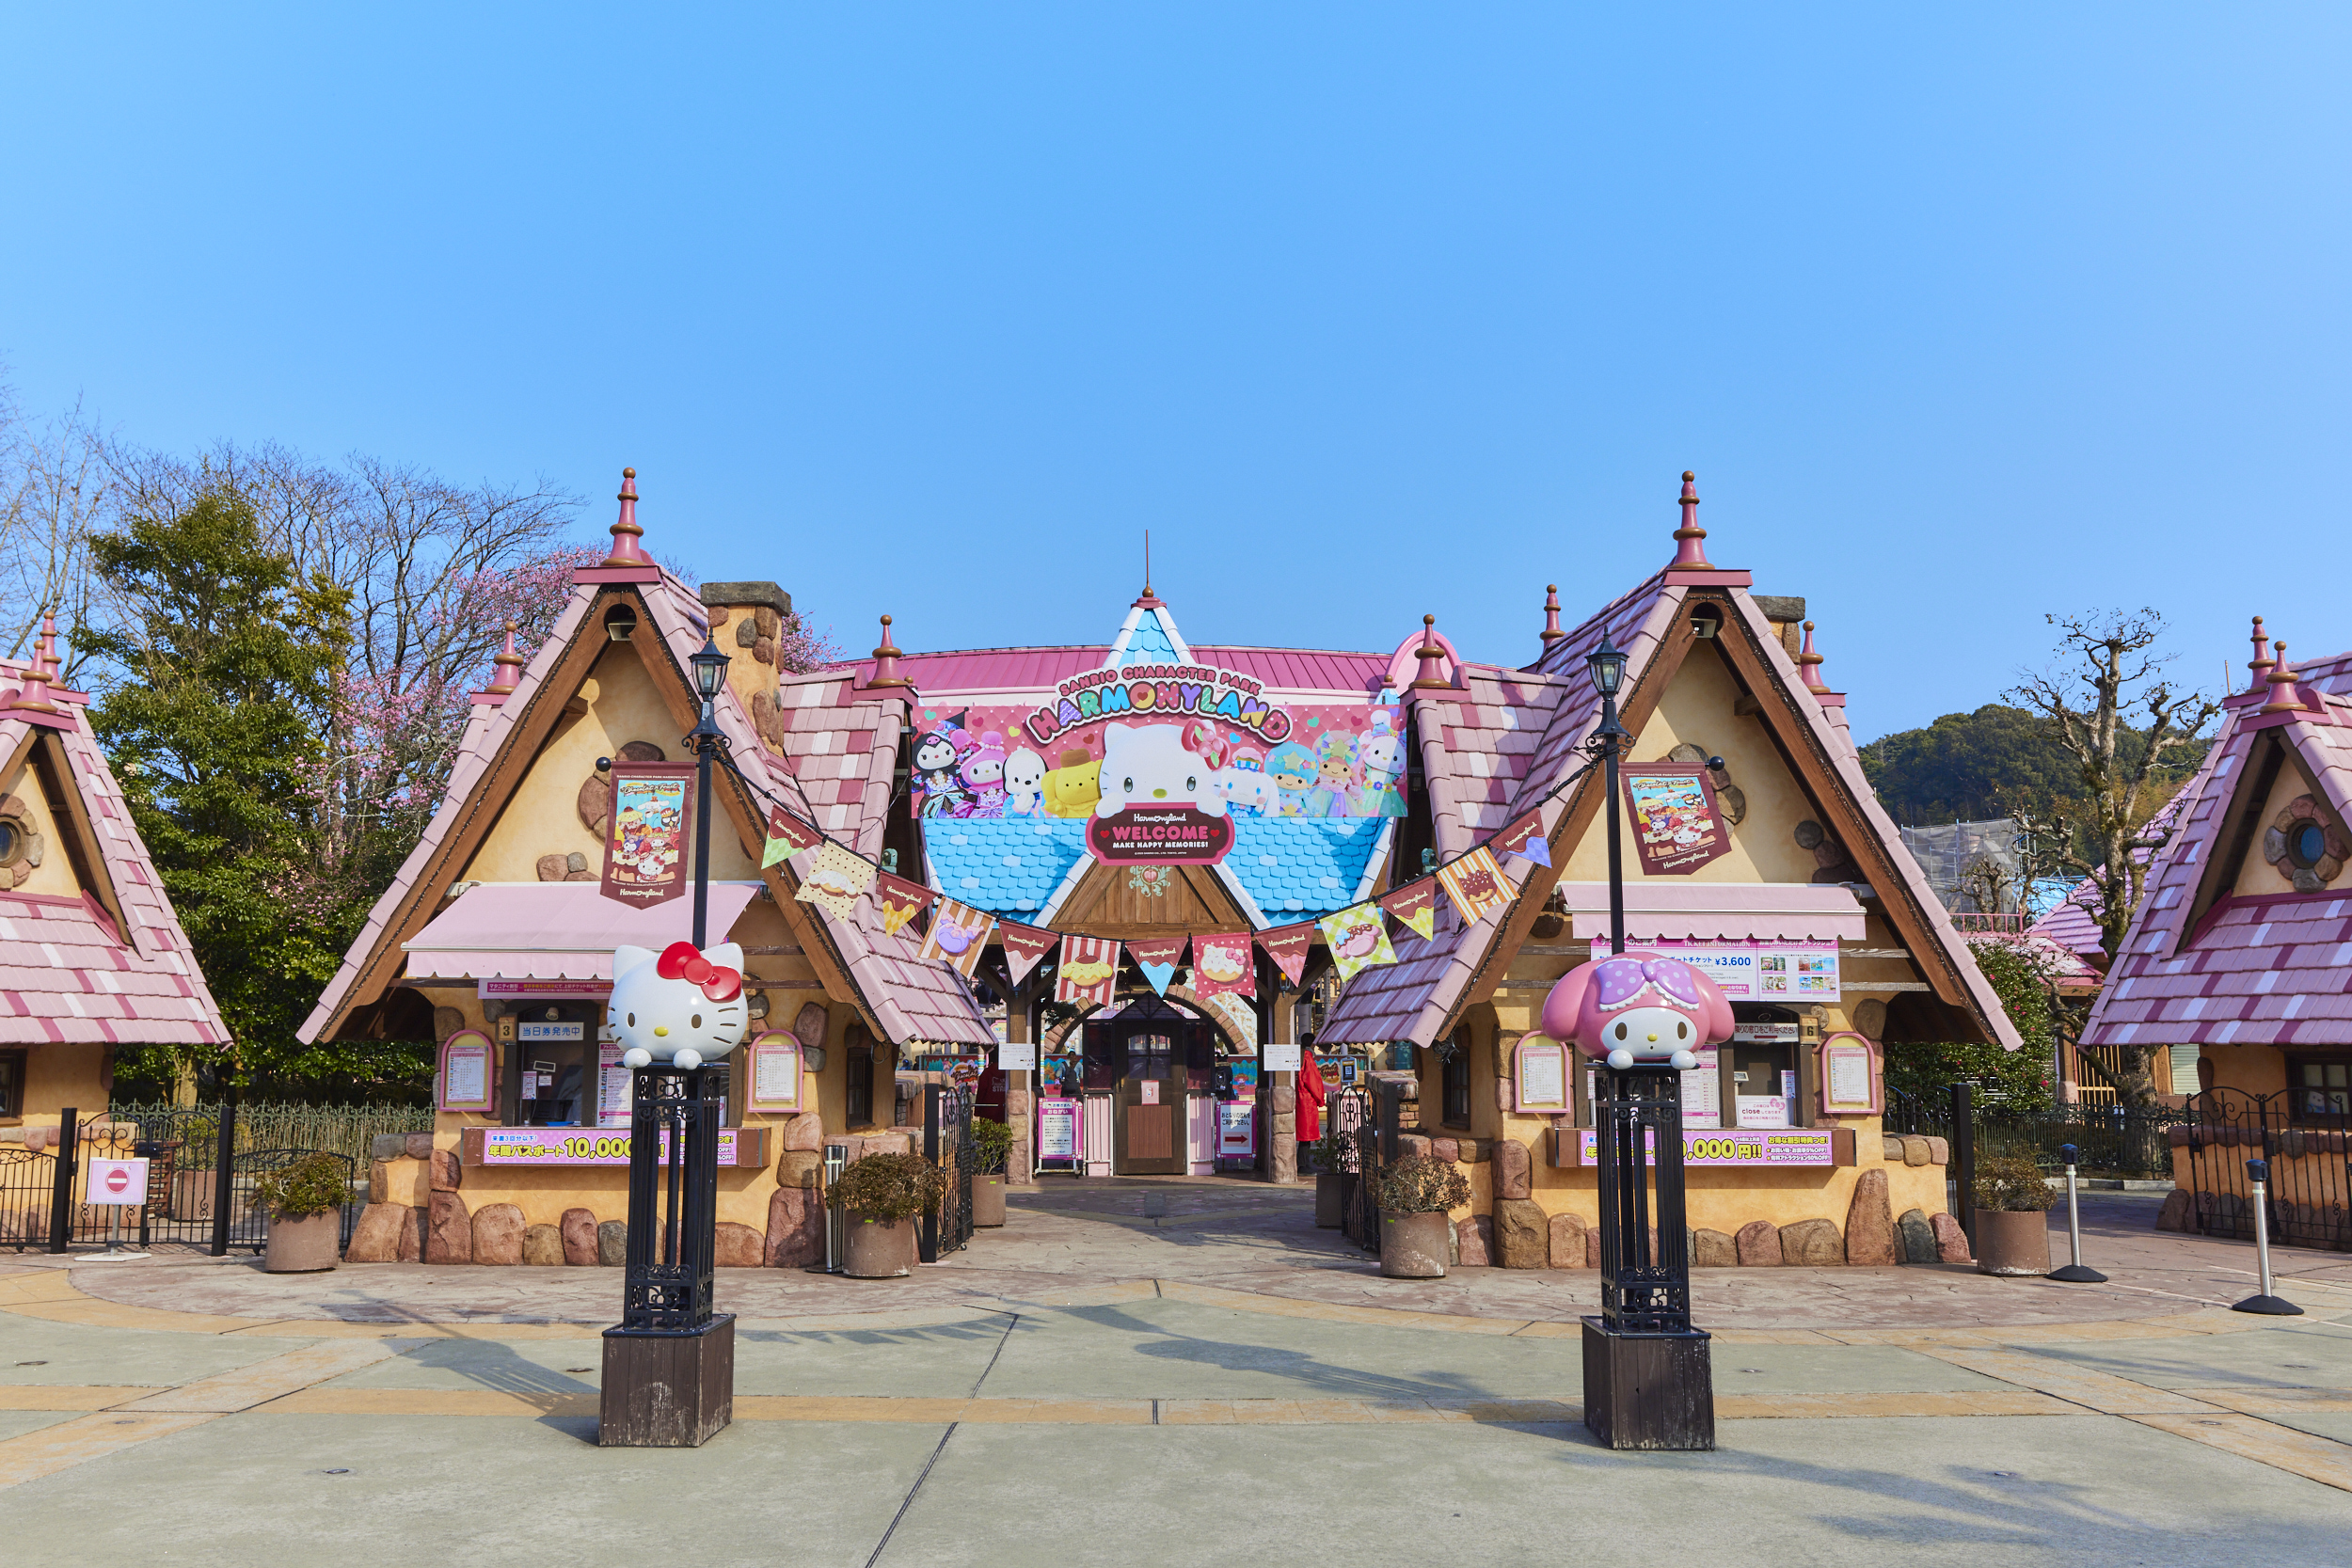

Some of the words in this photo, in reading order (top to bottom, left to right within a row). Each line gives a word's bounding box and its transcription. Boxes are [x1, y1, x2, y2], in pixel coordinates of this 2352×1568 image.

[1058, 669, 1118, 696] SANRIO
[1121, 665, 1216, 684] CHARACTER
[1219, 672, 1263, 696] PARK
[1029, 681, 1291, 741] HARMONYLAND
[1134, 813, 1186, 824] Harmonyland
[774, 818, 805, 845] Harmonyland
[1112, 826, 1209, 841] WELCOME
[1505, 821, 1537, 847] Harmonyland
[1662, 850, 1709, 869] Harmonyland
[619, 888, 664, 898] Harmonyland
[886, 885, 923, 904] Harmonyland
[1392, 891, 1429, 911] Harmonyland
[1007, 933, 1044, 948] Harmonyland
[1268, 933, 1306, 947] Harmonyland
[1138, 947, 1176, 958] Harmonyland
[1715, 957, 1751, 967] ¥3,600
[502, 1025, 511, 1037] 3
[523, 1026, 580, 1037] 当日券発売中
[1806, 1025, 1814, 1037] 6
